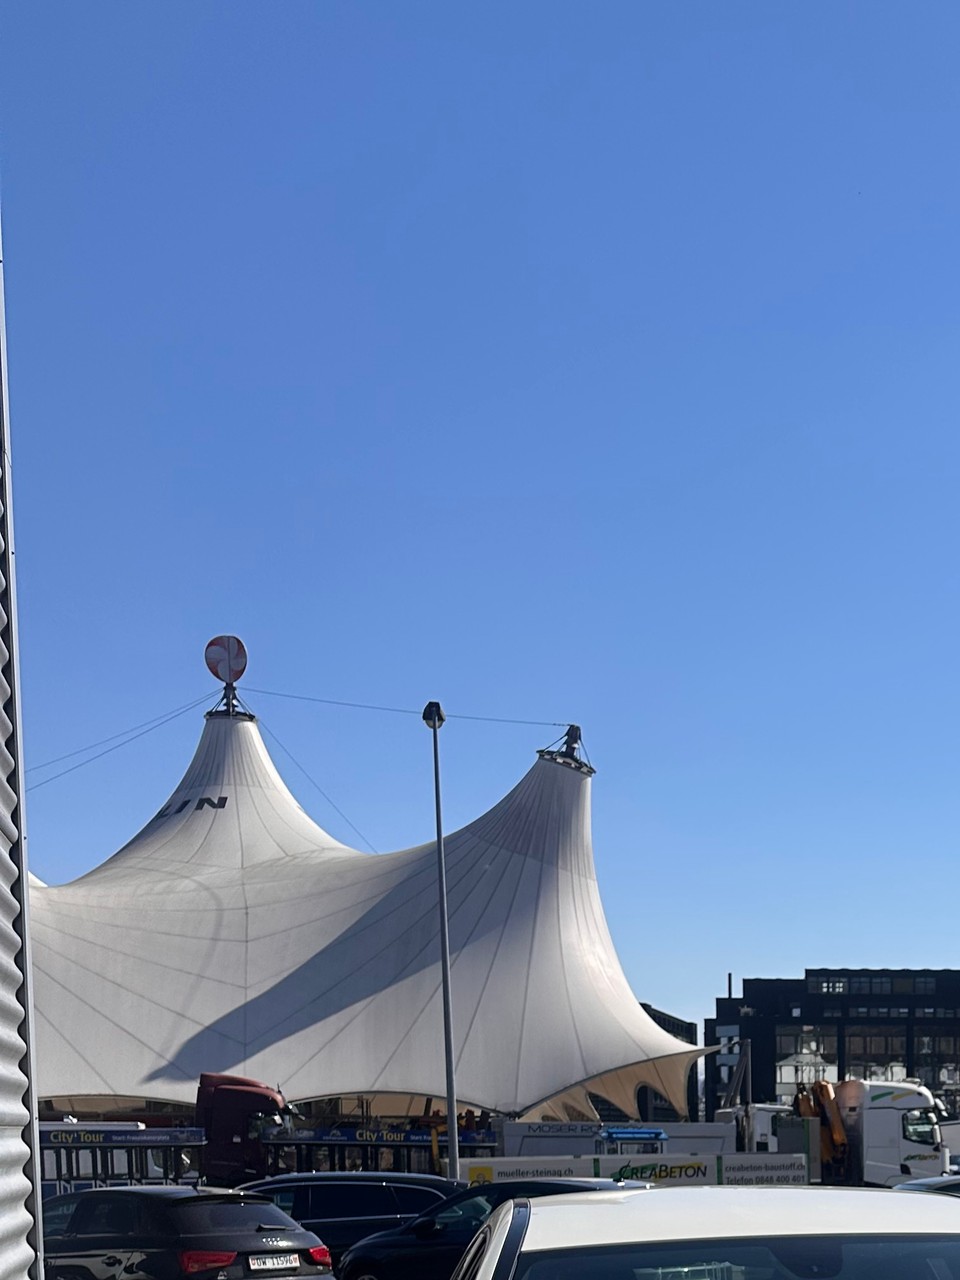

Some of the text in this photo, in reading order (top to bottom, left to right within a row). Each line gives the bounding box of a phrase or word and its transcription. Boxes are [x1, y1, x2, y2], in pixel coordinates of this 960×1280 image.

[528, 1124, 577, 1133] MOSER
[50, 1131, 73, 1144] City
[355, 1130, 378, 1141] City
[725, 1162, 806, 1171] creabeton-baustoff.ch
[497, 1167, 574, 1178] mueller-steinag.ch
[725, 1176, 754, 1185] Telefon
[776, 1175, 790, 1183] 400
[792, 1174, 805, 1183] 401
